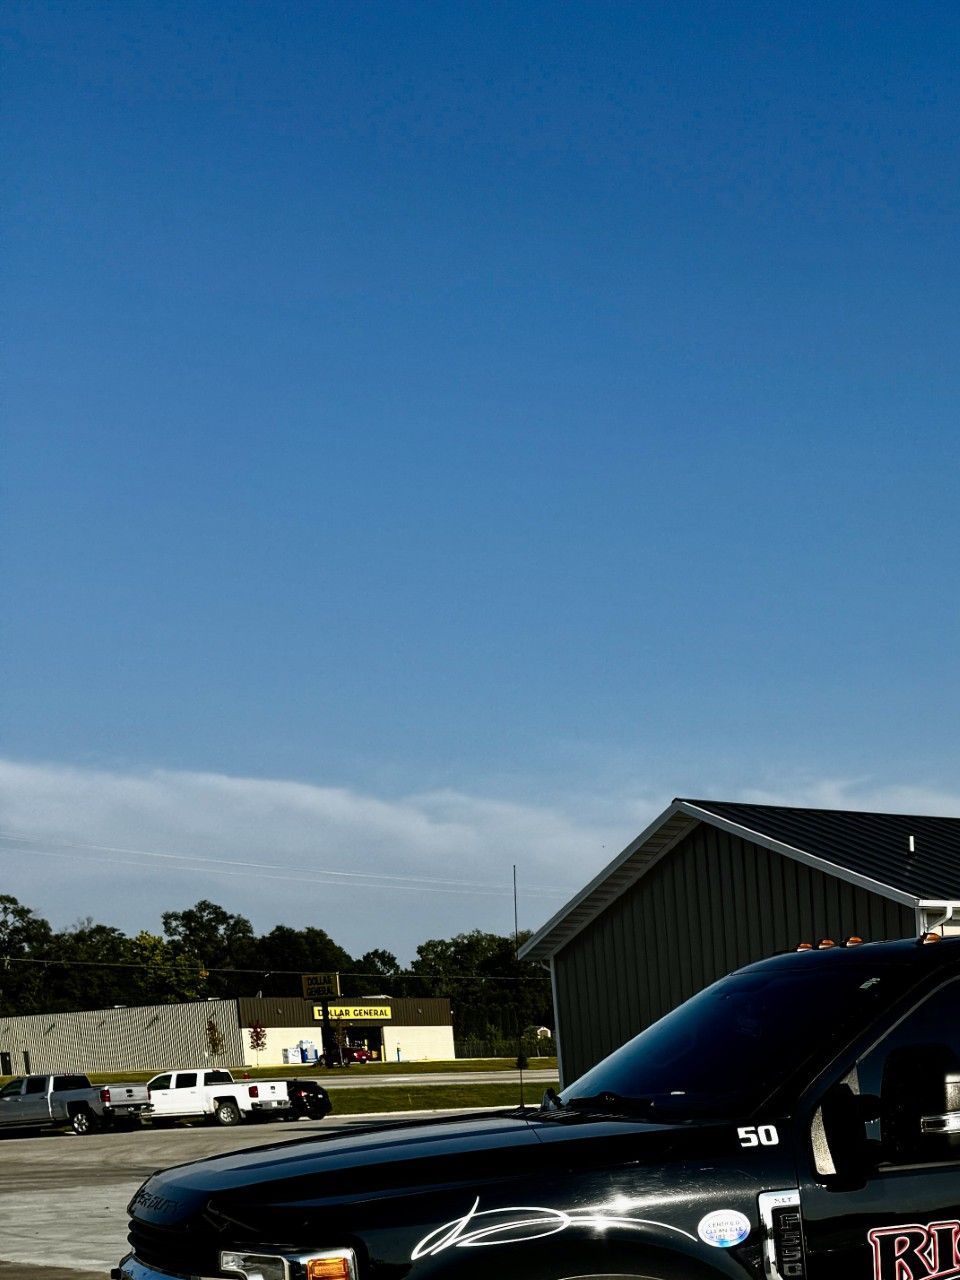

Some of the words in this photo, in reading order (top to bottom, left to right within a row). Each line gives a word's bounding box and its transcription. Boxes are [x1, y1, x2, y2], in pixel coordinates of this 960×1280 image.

[317, 1009, 351, 1017] DLLAR
[353, 1008, 389, 1017] GENERAL
[737, 1124, 779, 1147] 50
